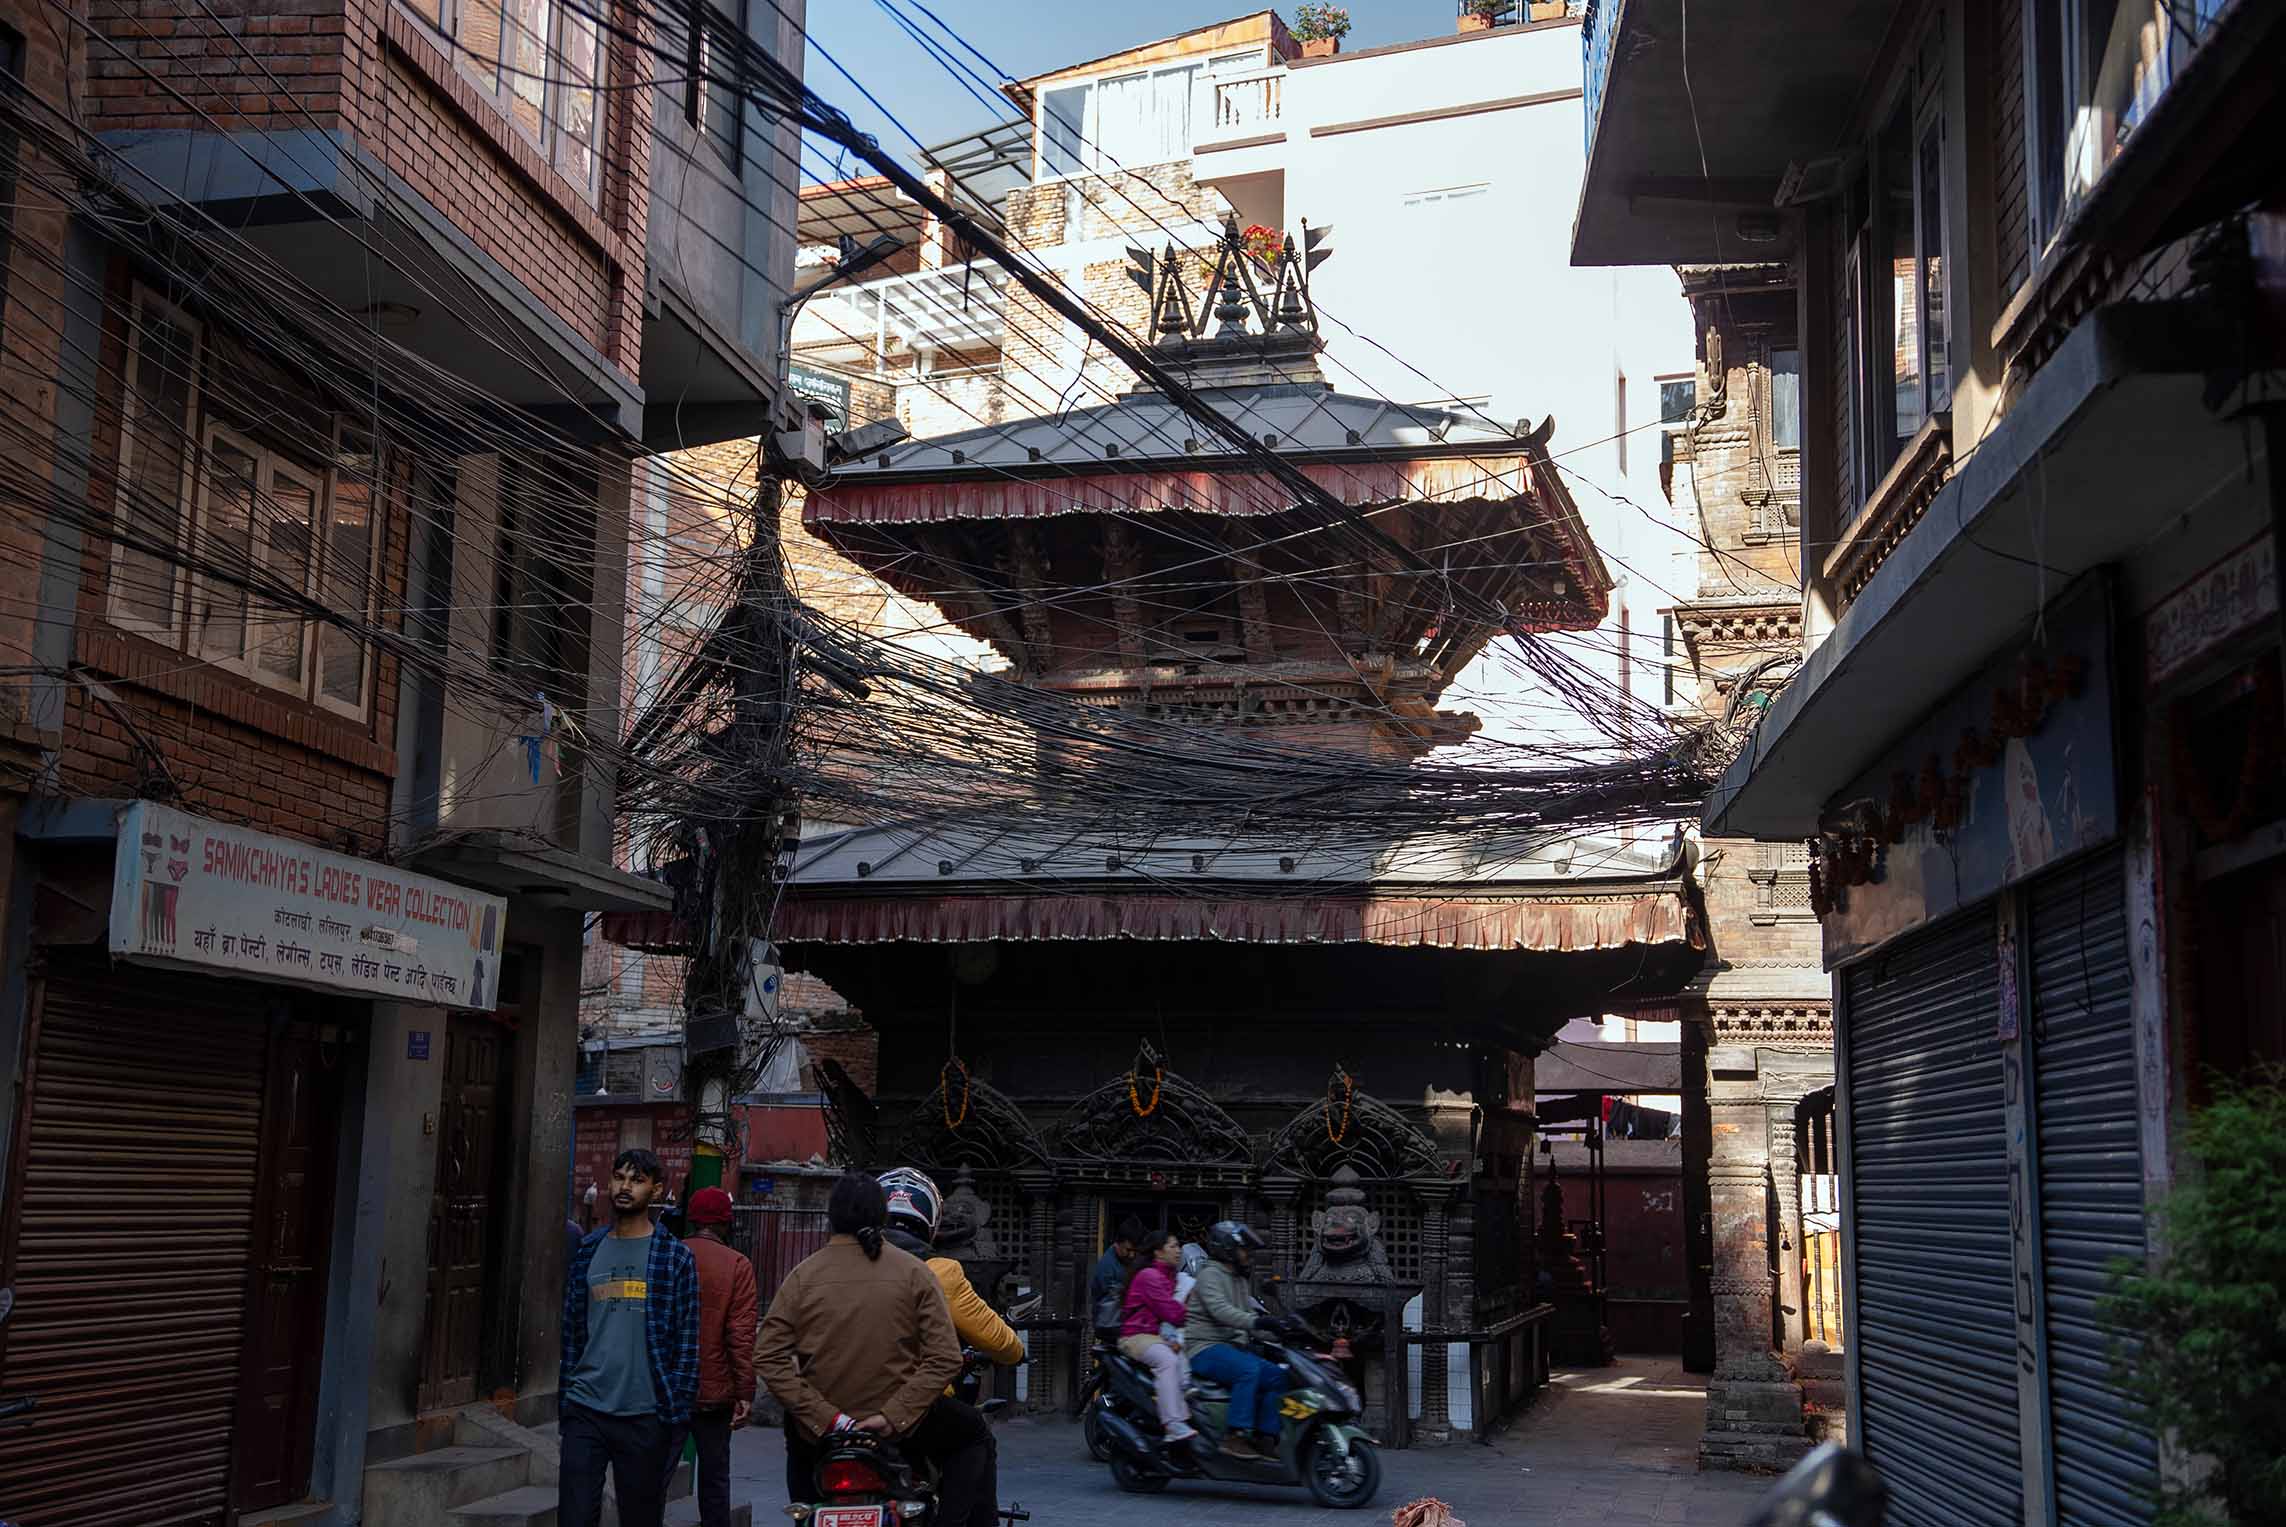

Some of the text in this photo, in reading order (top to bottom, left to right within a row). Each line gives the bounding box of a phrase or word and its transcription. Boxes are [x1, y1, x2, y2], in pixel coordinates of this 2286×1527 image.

[203, 838, 472, 932] SAMIKCHHYA'S LADIES WEAR COLLECTION
[193, 924, 216, 953] यहाँ
